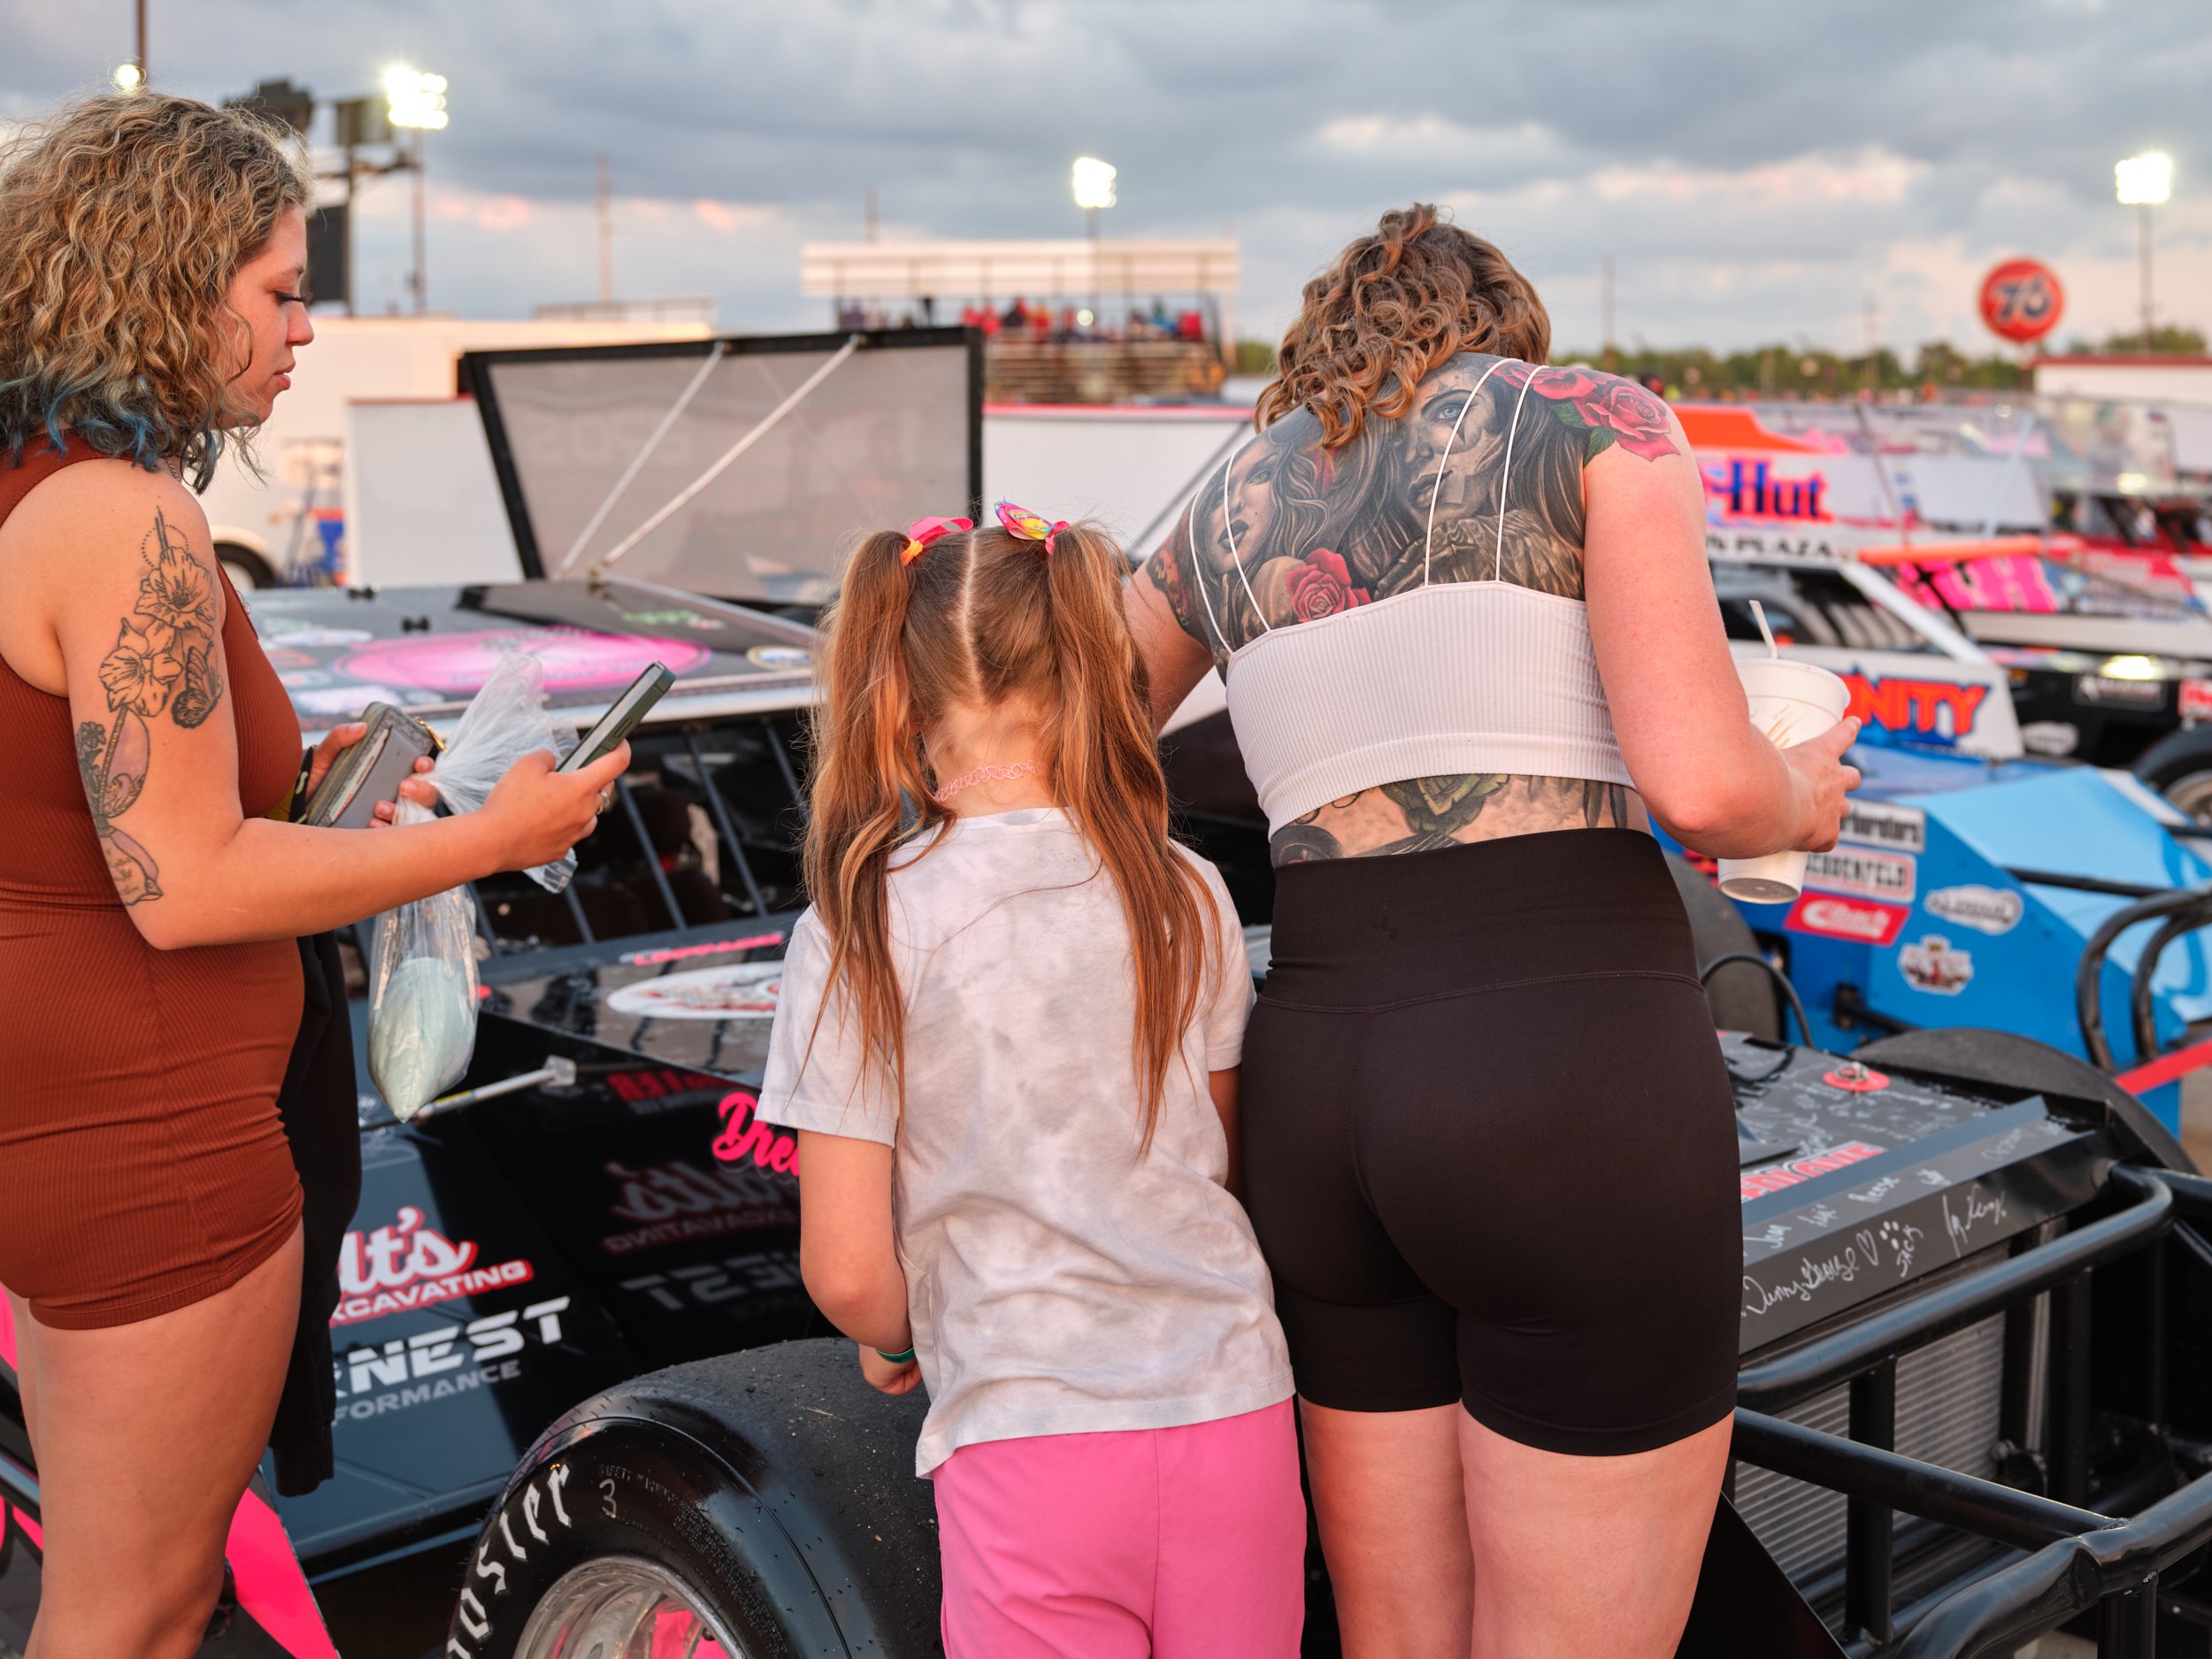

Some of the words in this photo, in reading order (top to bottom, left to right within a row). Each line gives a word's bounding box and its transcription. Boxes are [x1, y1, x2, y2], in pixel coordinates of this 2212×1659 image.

[1993, 276, 2051, 322] 76
[1712, 459, 1824, 517] Hut
[598, 1478, 618, 1518] 3
